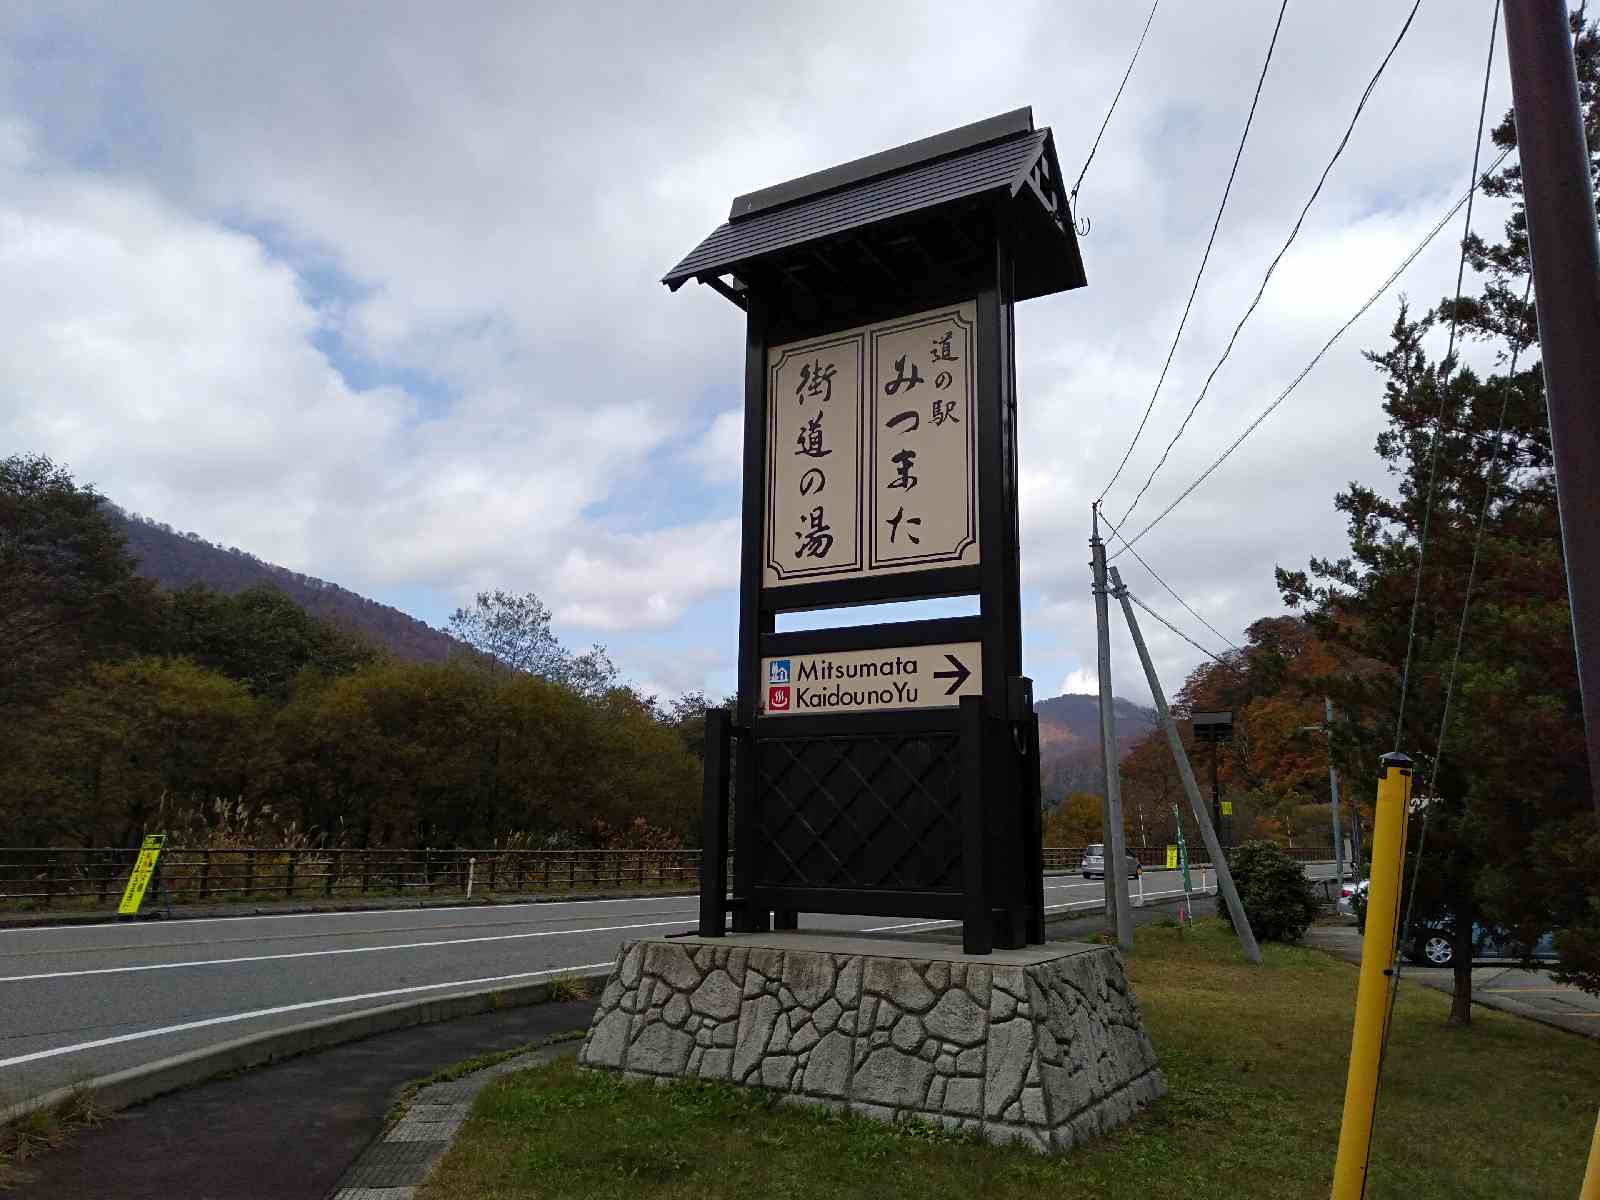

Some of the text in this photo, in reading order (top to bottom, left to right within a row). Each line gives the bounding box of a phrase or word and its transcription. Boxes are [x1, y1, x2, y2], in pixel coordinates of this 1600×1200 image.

[928, 331, 960, 426] 道の駅
[795, 359, 837, 559] 街道の湯
[885, 354, 924, 544] みつまた
[796, 682, 918, 708] KaidounoYu
[797, 656, 918, 681] Mitsumata
